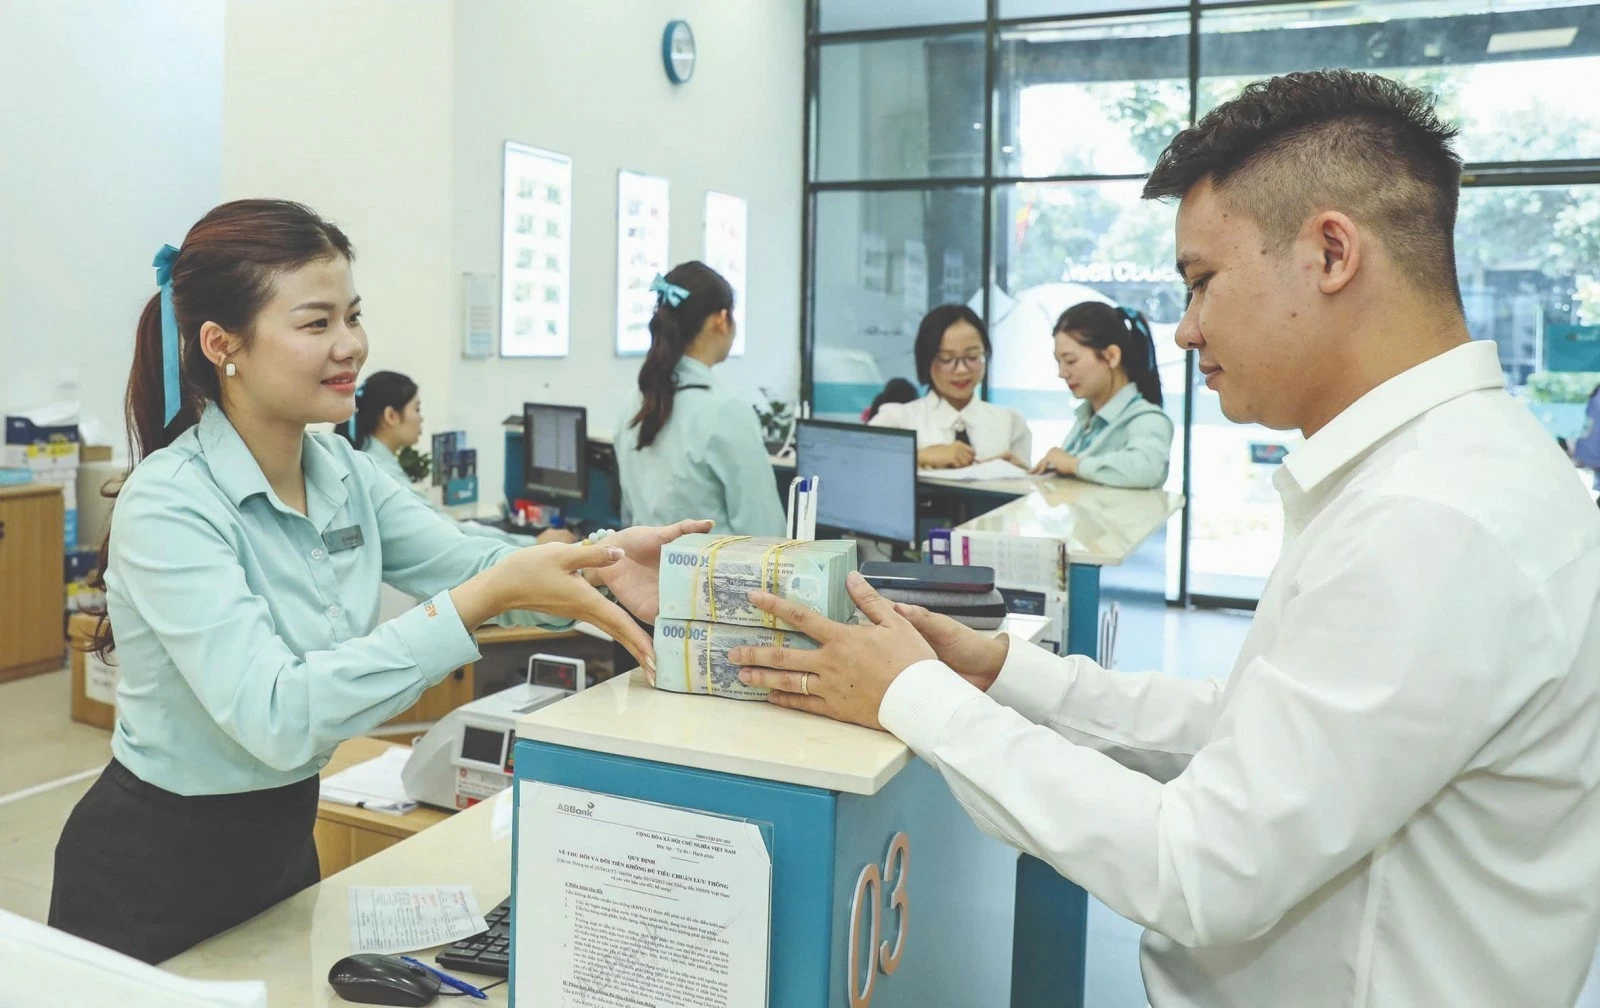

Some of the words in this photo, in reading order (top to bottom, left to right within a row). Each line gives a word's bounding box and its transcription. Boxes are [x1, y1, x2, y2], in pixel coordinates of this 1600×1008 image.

[557, 803, 593, 817] ABBank
[626, 863, 647, 872] KHÔNG
[708, 880, 729, 889] THÔNG
[848, 832, 910, 1008] 03
